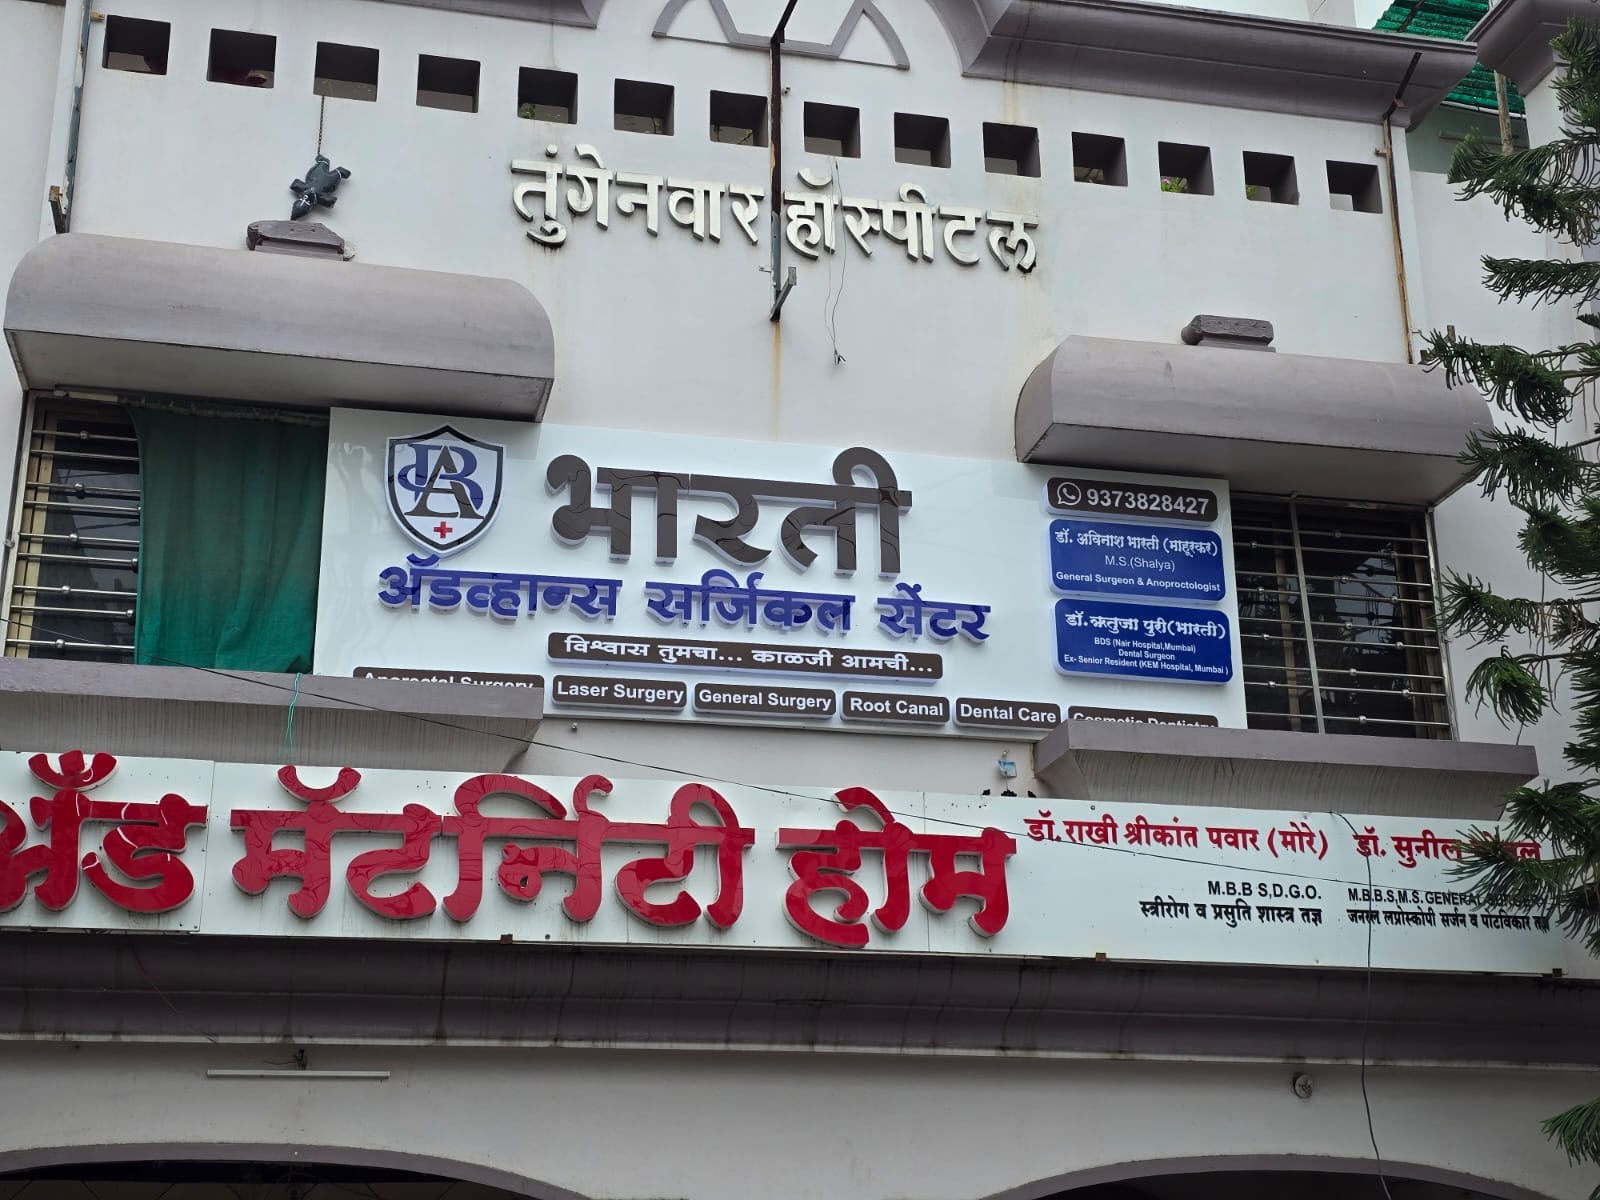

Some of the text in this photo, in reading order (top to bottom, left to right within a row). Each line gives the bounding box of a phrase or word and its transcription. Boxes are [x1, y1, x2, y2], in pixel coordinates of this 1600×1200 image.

[511, 144, 1040, 274] तुंगेनवार हॉस्पीटल
[546, 446, 913, 577] भारती
[1086, 488, 1209, 515] 9373828427
[1055, 527, 1073, 544] डॉ.
[1076, 529, 1124, 549] अविनाश
[1127, 534, 1159, 551] भारती
[1105, 555, 1176, 573] M.S.(Shalya)
[1056, 571, 1221, 593] General Surgeon & Anoproctologist
[645, 568, 856, 637] सर्जिकल
[877, 582, 991, 642] सेंटर
[564, 635, 650, 657] विश्वास
[751, 649, 834, 667] काळजी
[1094, 637, 1111, 646] BDS
[1113, 638, 1131, 648] (Nair
[1078, 655, 1103, 665] Senior
[1104, 658, 1138, 668] Resident
[1139, 661, 1159, 671] (KEM
[1161, 662, 1194, 674] Hospital,
[1118, 648, 1176, 661] Dental Surgeon
[557, 681, 684, 704] Laser Surgery
[699, 689, 832, 711] General Surgery
[850, 697, 943, 716] Root Canal
[960, 703, 1013, 720] Dental
[1018, 707, 1057, 723] Care
[1124, 815, 1199, 849] श्रीकांत
[1205, 827, 1261, 851] पवार
[1267, 821, 1329, 860] (मोरे)
[1352, 826, 1387, 857] डॉ.
[1391, 829, 1462, 869] सुनील
[775, 786, 1017, 948] होम
[1139, 894, 1190, 919] स्त्रीरोग
[1194, 902, 1207, 919] व
[1256, 904, 1295, 923] शास्त्र
[1299, 907, 1323, 926] तज्ञ
[1439, 906, 1467, 928] सर्जन
[1468, 913, 1479, 928] व
